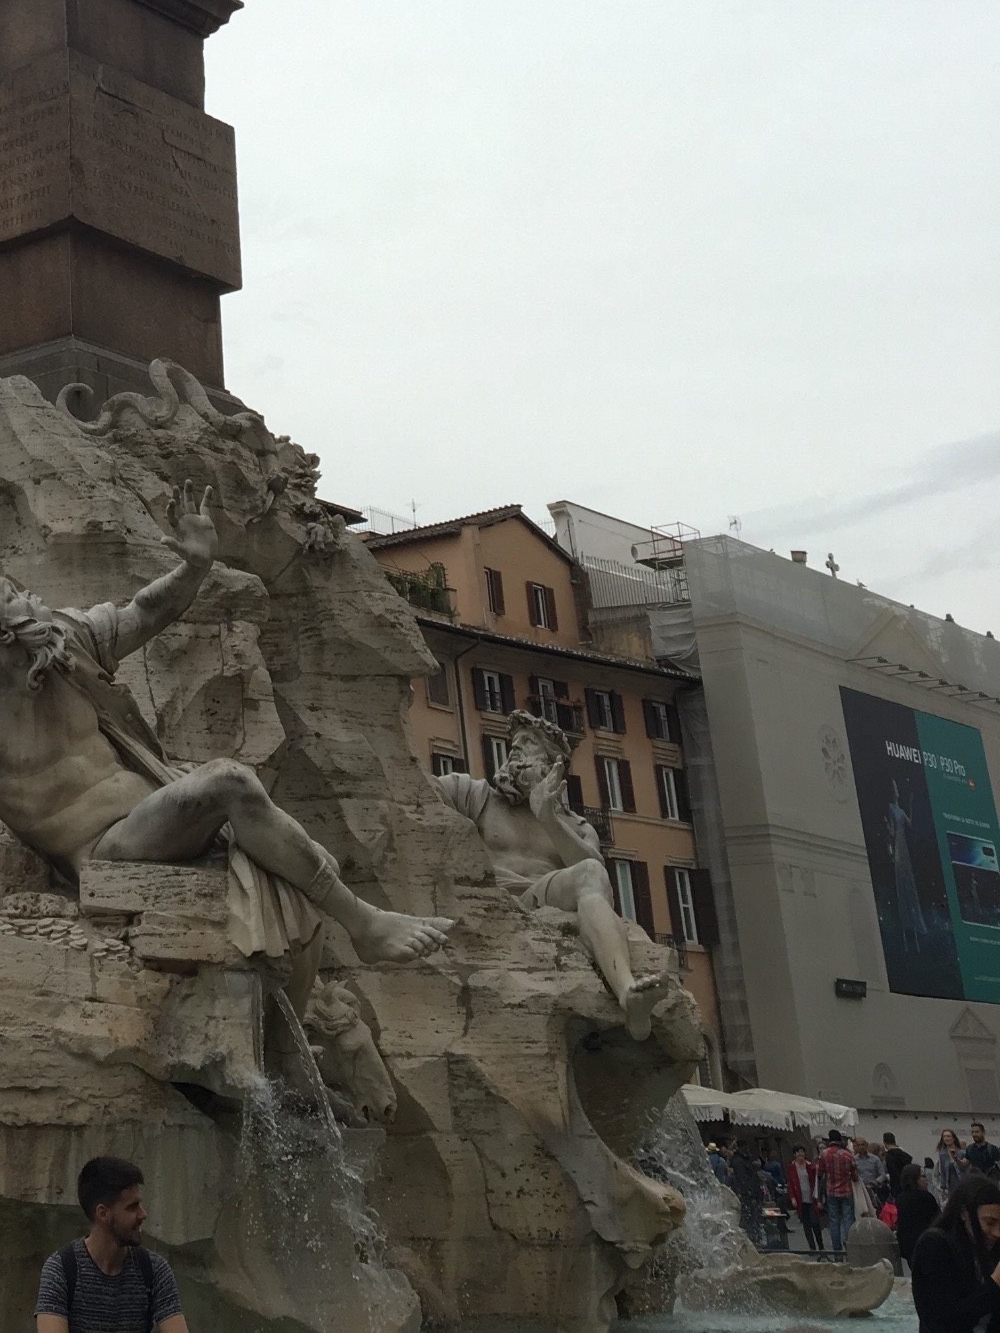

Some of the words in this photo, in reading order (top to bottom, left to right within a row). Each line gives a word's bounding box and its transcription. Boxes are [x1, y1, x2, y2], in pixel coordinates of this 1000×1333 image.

[885, 740, 922, 764] HUAWEI
[922, 751, 937, 769] P30
[939, 756, 954, 773] P30
[954, 760, 966, 777] Pro
